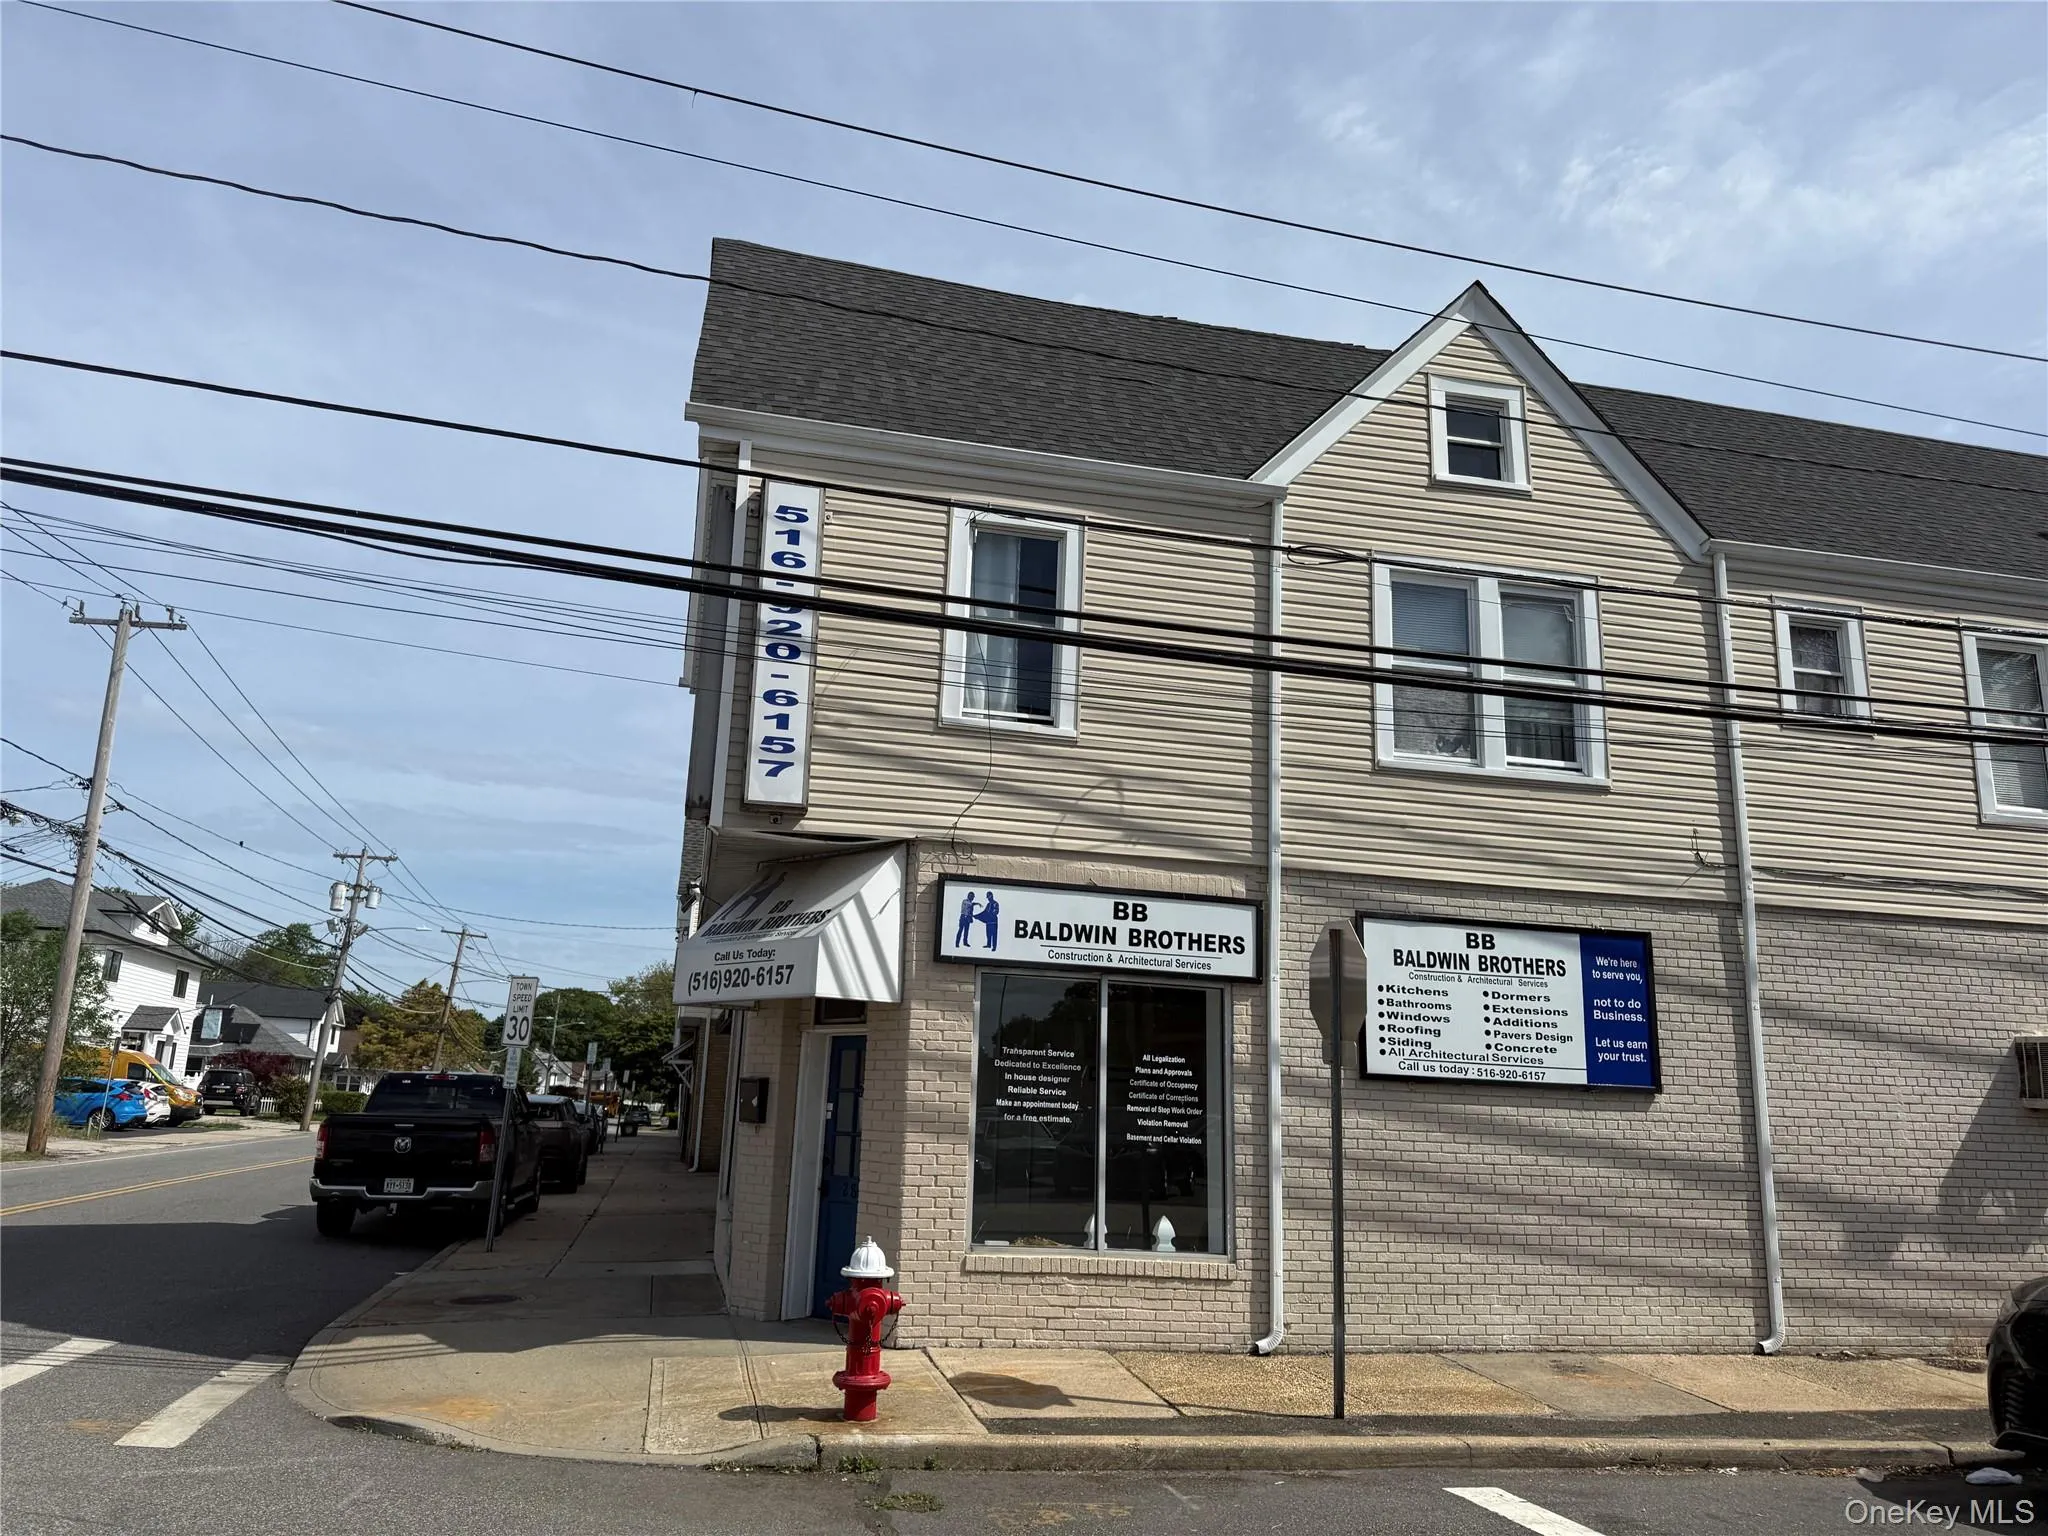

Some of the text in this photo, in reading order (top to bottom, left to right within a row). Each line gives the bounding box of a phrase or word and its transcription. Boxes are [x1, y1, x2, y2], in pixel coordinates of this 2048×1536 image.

[1112, 900, 1148, 922] BB
[700, 909, 832, 937] BALDWIN BROTHERS
[1014, 919, 1246, 955] BALDWIN BROTHERS
[1465, 932, 1496, 950] BB
[714, 947, 776, 961] Call Us Today:
[1047, 949, 1212, 970] Construction & Architectural Services
[1393, 948, 1567, 977] BALDWIN BROTHERS
[1595, 955, 1638, 968] We're here
[687, 963, 795, 997] (516)920-6157
[1408, 971, 1549, 988] Construction & Architectural Services
[1592, 969, 1643, 985] to serve you,
[516, 982, 533, 991] TOWN
[1385, 984, 1449, 997] Kitchens
[512, 993, 533, 1003] SPEED
[1491, 991, 1551, 1002] Dormers
[512, 1005, 529, 1014] LIMIT
[1386, 998, 1452, 1011] Bathrooms
[1593, 998, 1642, 1009] not to do
[1492, 1004, 1569, 1017] Extensions
[1593, 1009, 1646, 1022] Business.
[1386, 1011, 1451, 1024] Windows
[1492, 1017, 1558, 1029] Additions
[506, 1015, 530, 1042] 30
[1387, 1024, 1441, 1038] Roofing
[1387, 1036, 1432, 1050] Siding
[1493, 1029, 1574, 1044] Pavers Design
[1494, 1042, 1558, 1054] Concrete
[1595, 1037, 1648, 1050] Let us earn
[1002, 1046, 1075, 1058] Transparent Service
[1388, 1047, 1544, 1065] All Architectural Services
[1597, 1051, 1647, 1063] your trust.
[994, 1059, 1082, 1072] Dedicated to Excellence
[1142, 1054, 1186, 1064] All Legalization
[1135, 1066, 1193, 1077] Plans and Approvals
[1398, 1060, 1420, 1072] Call
[1422, 1063, 1436, 1072] us
[1476, 1067, 1546, 1081] 516-920-6157
[1004, 1072, 1071, 1085] In house designer
[1129, 1078, 1159, 1088] Certificate
[1166, 1080, 1199, 1091] Occupancy
[1007, 1085, 1067, 1096] Reliable Service
[1128, 1091, 1158, 1100] Certificate
[1165, 1093, 1199, 1103] Corrections
[996, 1098, 1012, 1107] Make
[1022, 1100, 1061, 1109] appointment
[1126, 1104, 1203, 1116] Removal of Stop Work Order
[1004, 1113, 1015, 1121] for
[1023, 1113, 1038, 1122] free
[1038, 1114, 1073, 1124] estimate.
[1137, 1118, 1189, 1129] Violation Removal
[1126, 1132, 1153, 1142] Basement
[1163, 1135, 1179, 1143] Cellar
[1179, 1136, 1202, 1145] Violation
